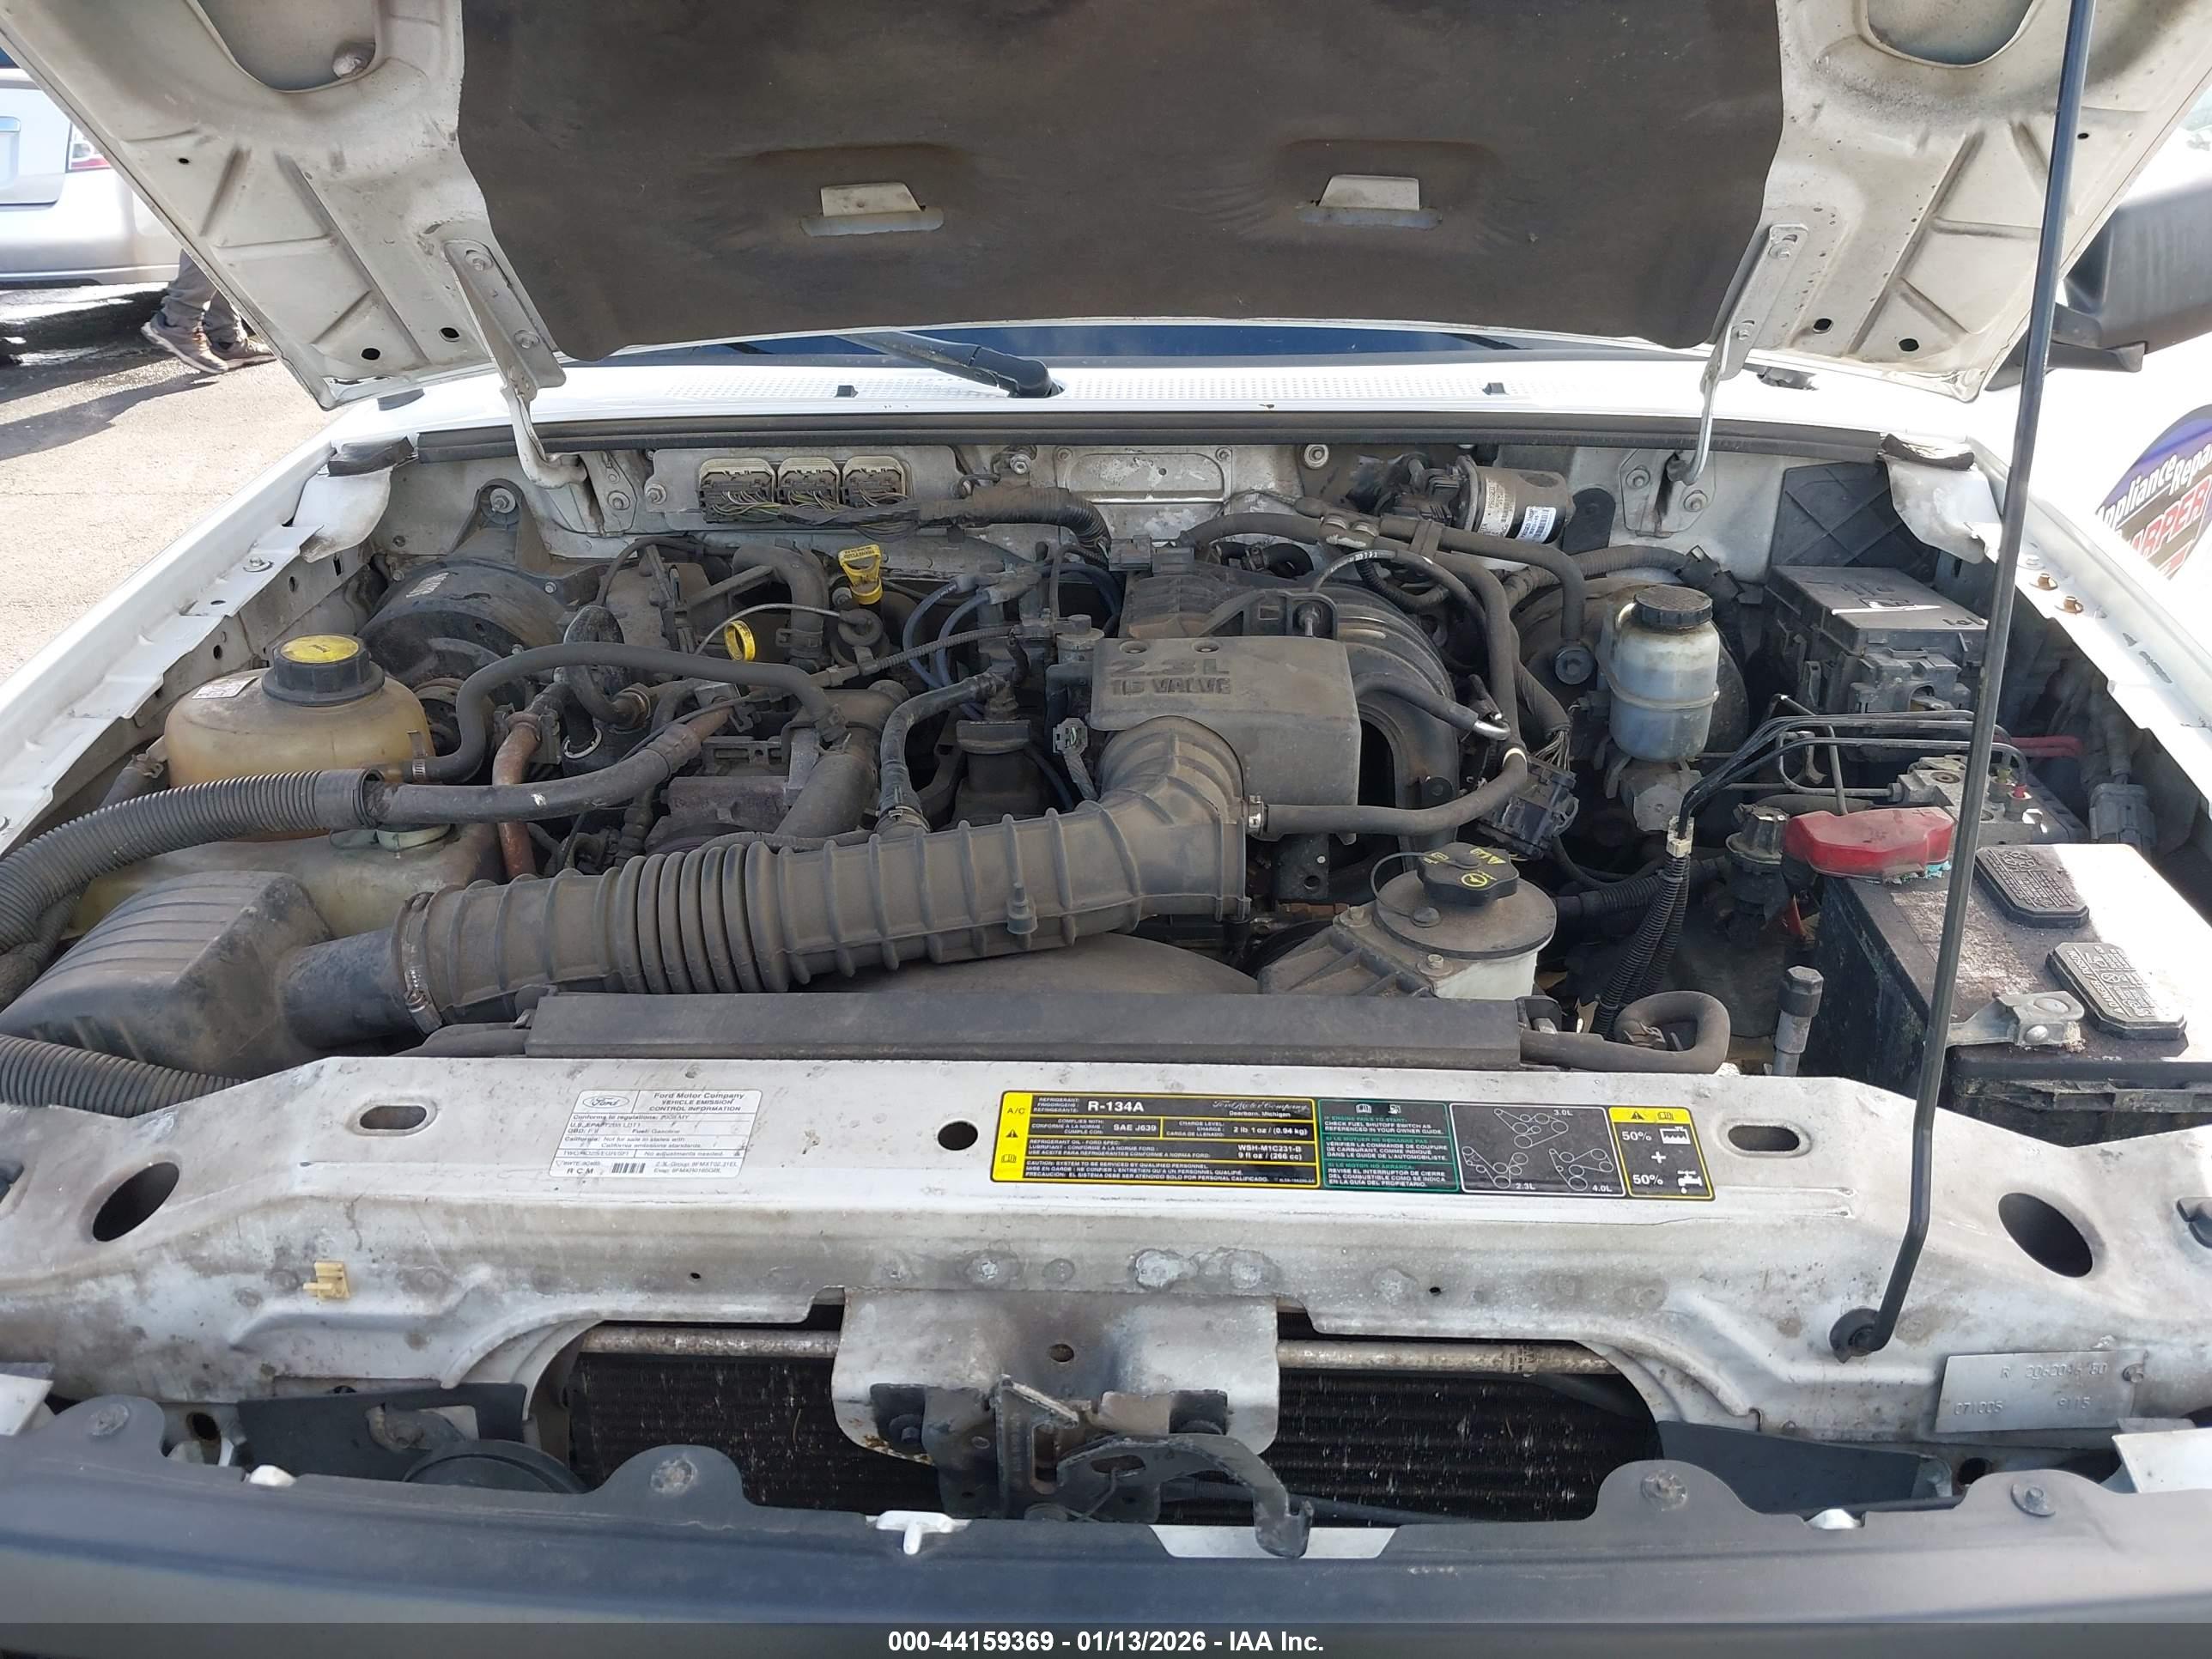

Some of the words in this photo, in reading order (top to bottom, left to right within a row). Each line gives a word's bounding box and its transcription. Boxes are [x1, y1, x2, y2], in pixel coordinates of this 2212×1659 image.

[1152, 678, 1231, 694] VALVE
[2067, 950, 2092, 975] POISON
[1088, 1101, 1144, 1112] R-134A
[1295, 1127, 1308, 1136] kg)
[1622, 1131, 1652, 1141] 50%
[1632, 1175, 1663, 1185] 50%
